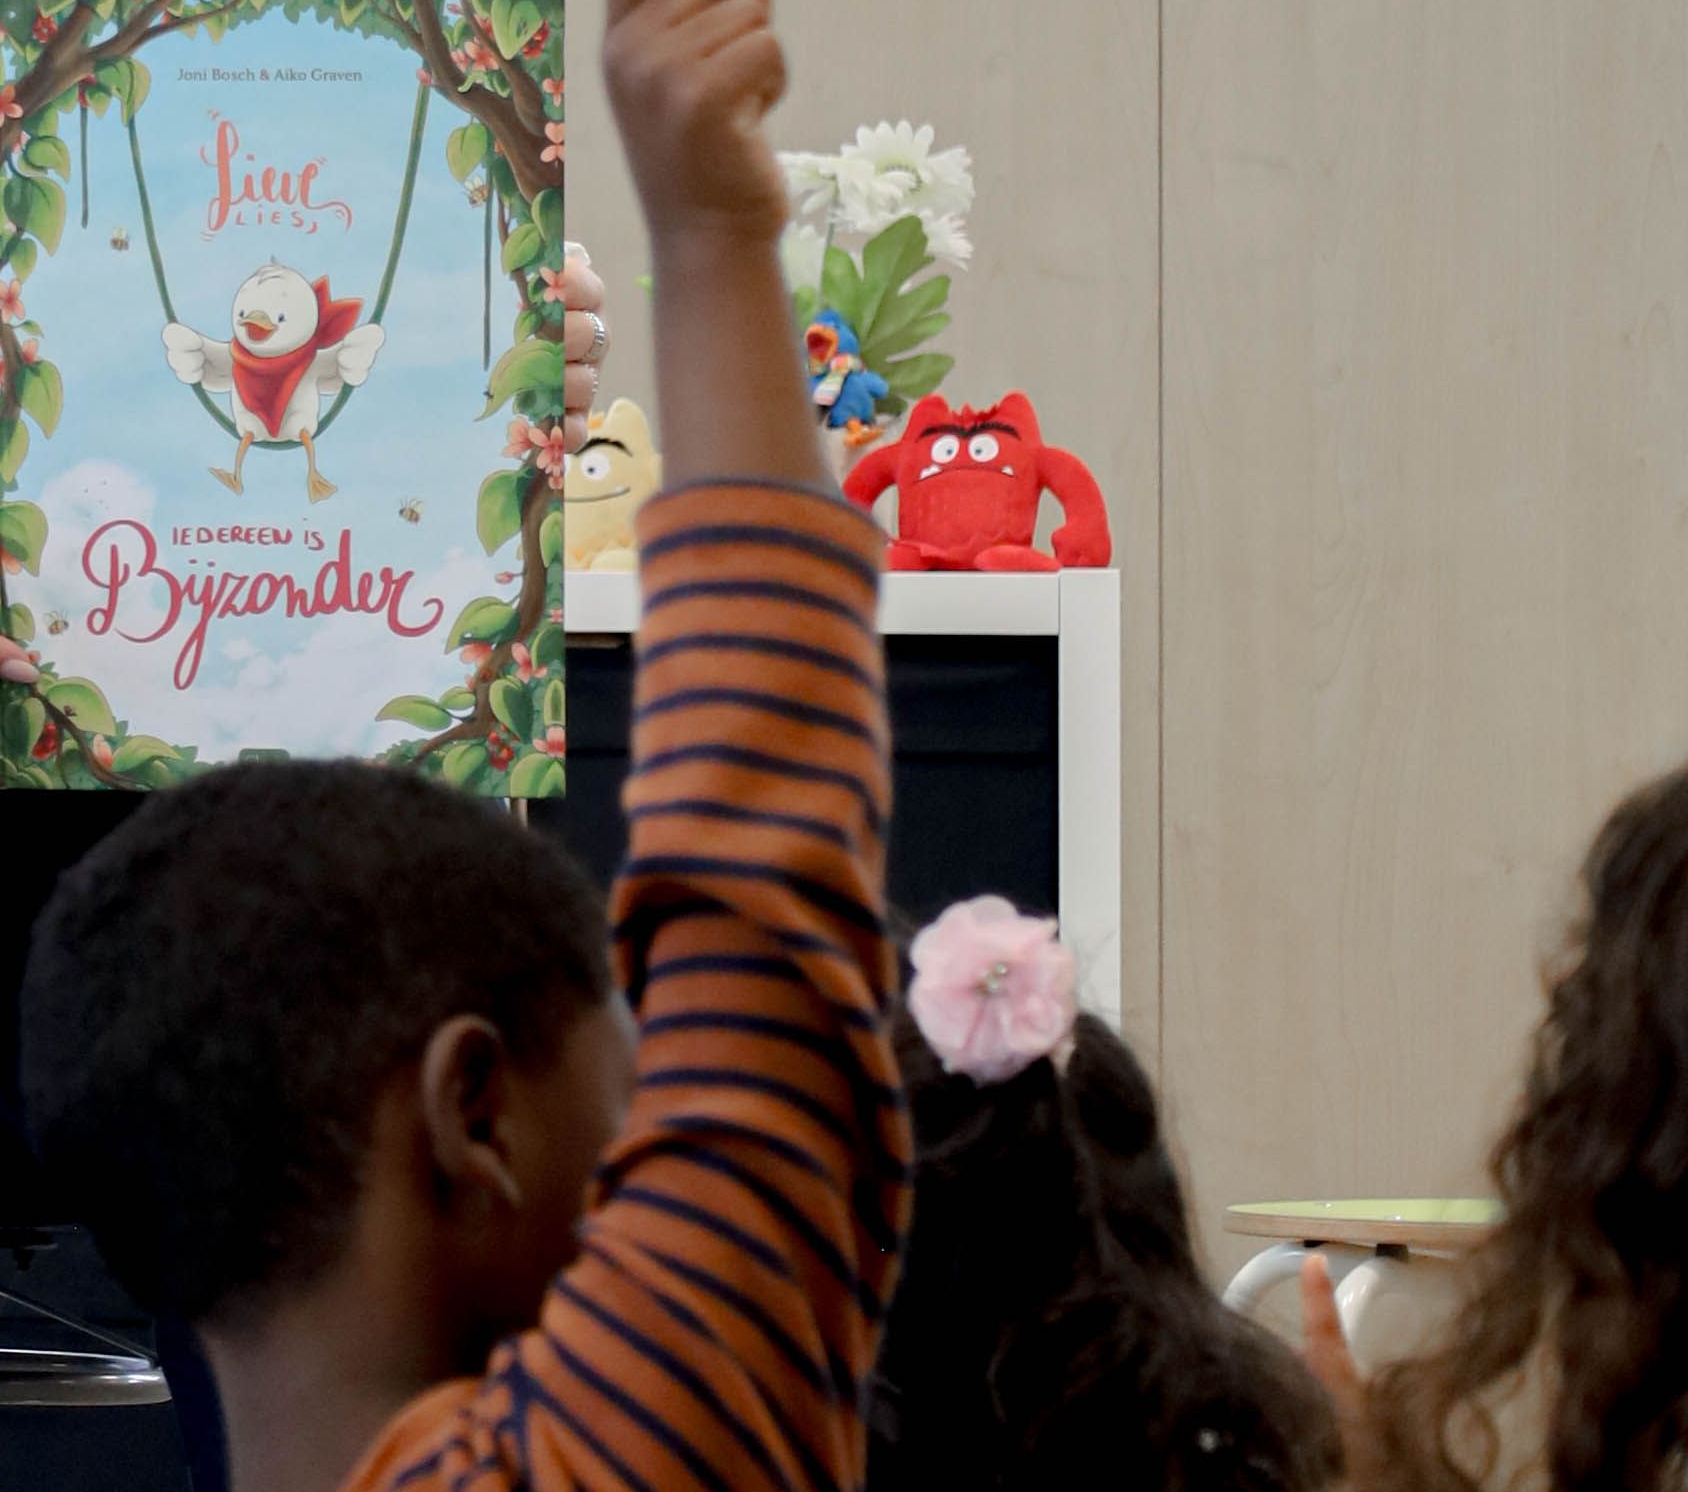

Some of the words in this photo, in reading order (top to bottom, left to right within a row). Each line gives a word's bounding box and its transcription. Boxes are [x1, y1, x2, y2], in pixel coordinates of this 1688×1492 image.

[177, 68, 208, 82] Joni
[212, 68, 256, 82] Bosch
[259, 69, 270, 82] &
[274, 68, 307, 82] Aiko
[311, 68, 362, 82] Graven
[172, 525, 293, 546] IEDEREEN
[81, 519, 444, 690] Bijzonder
